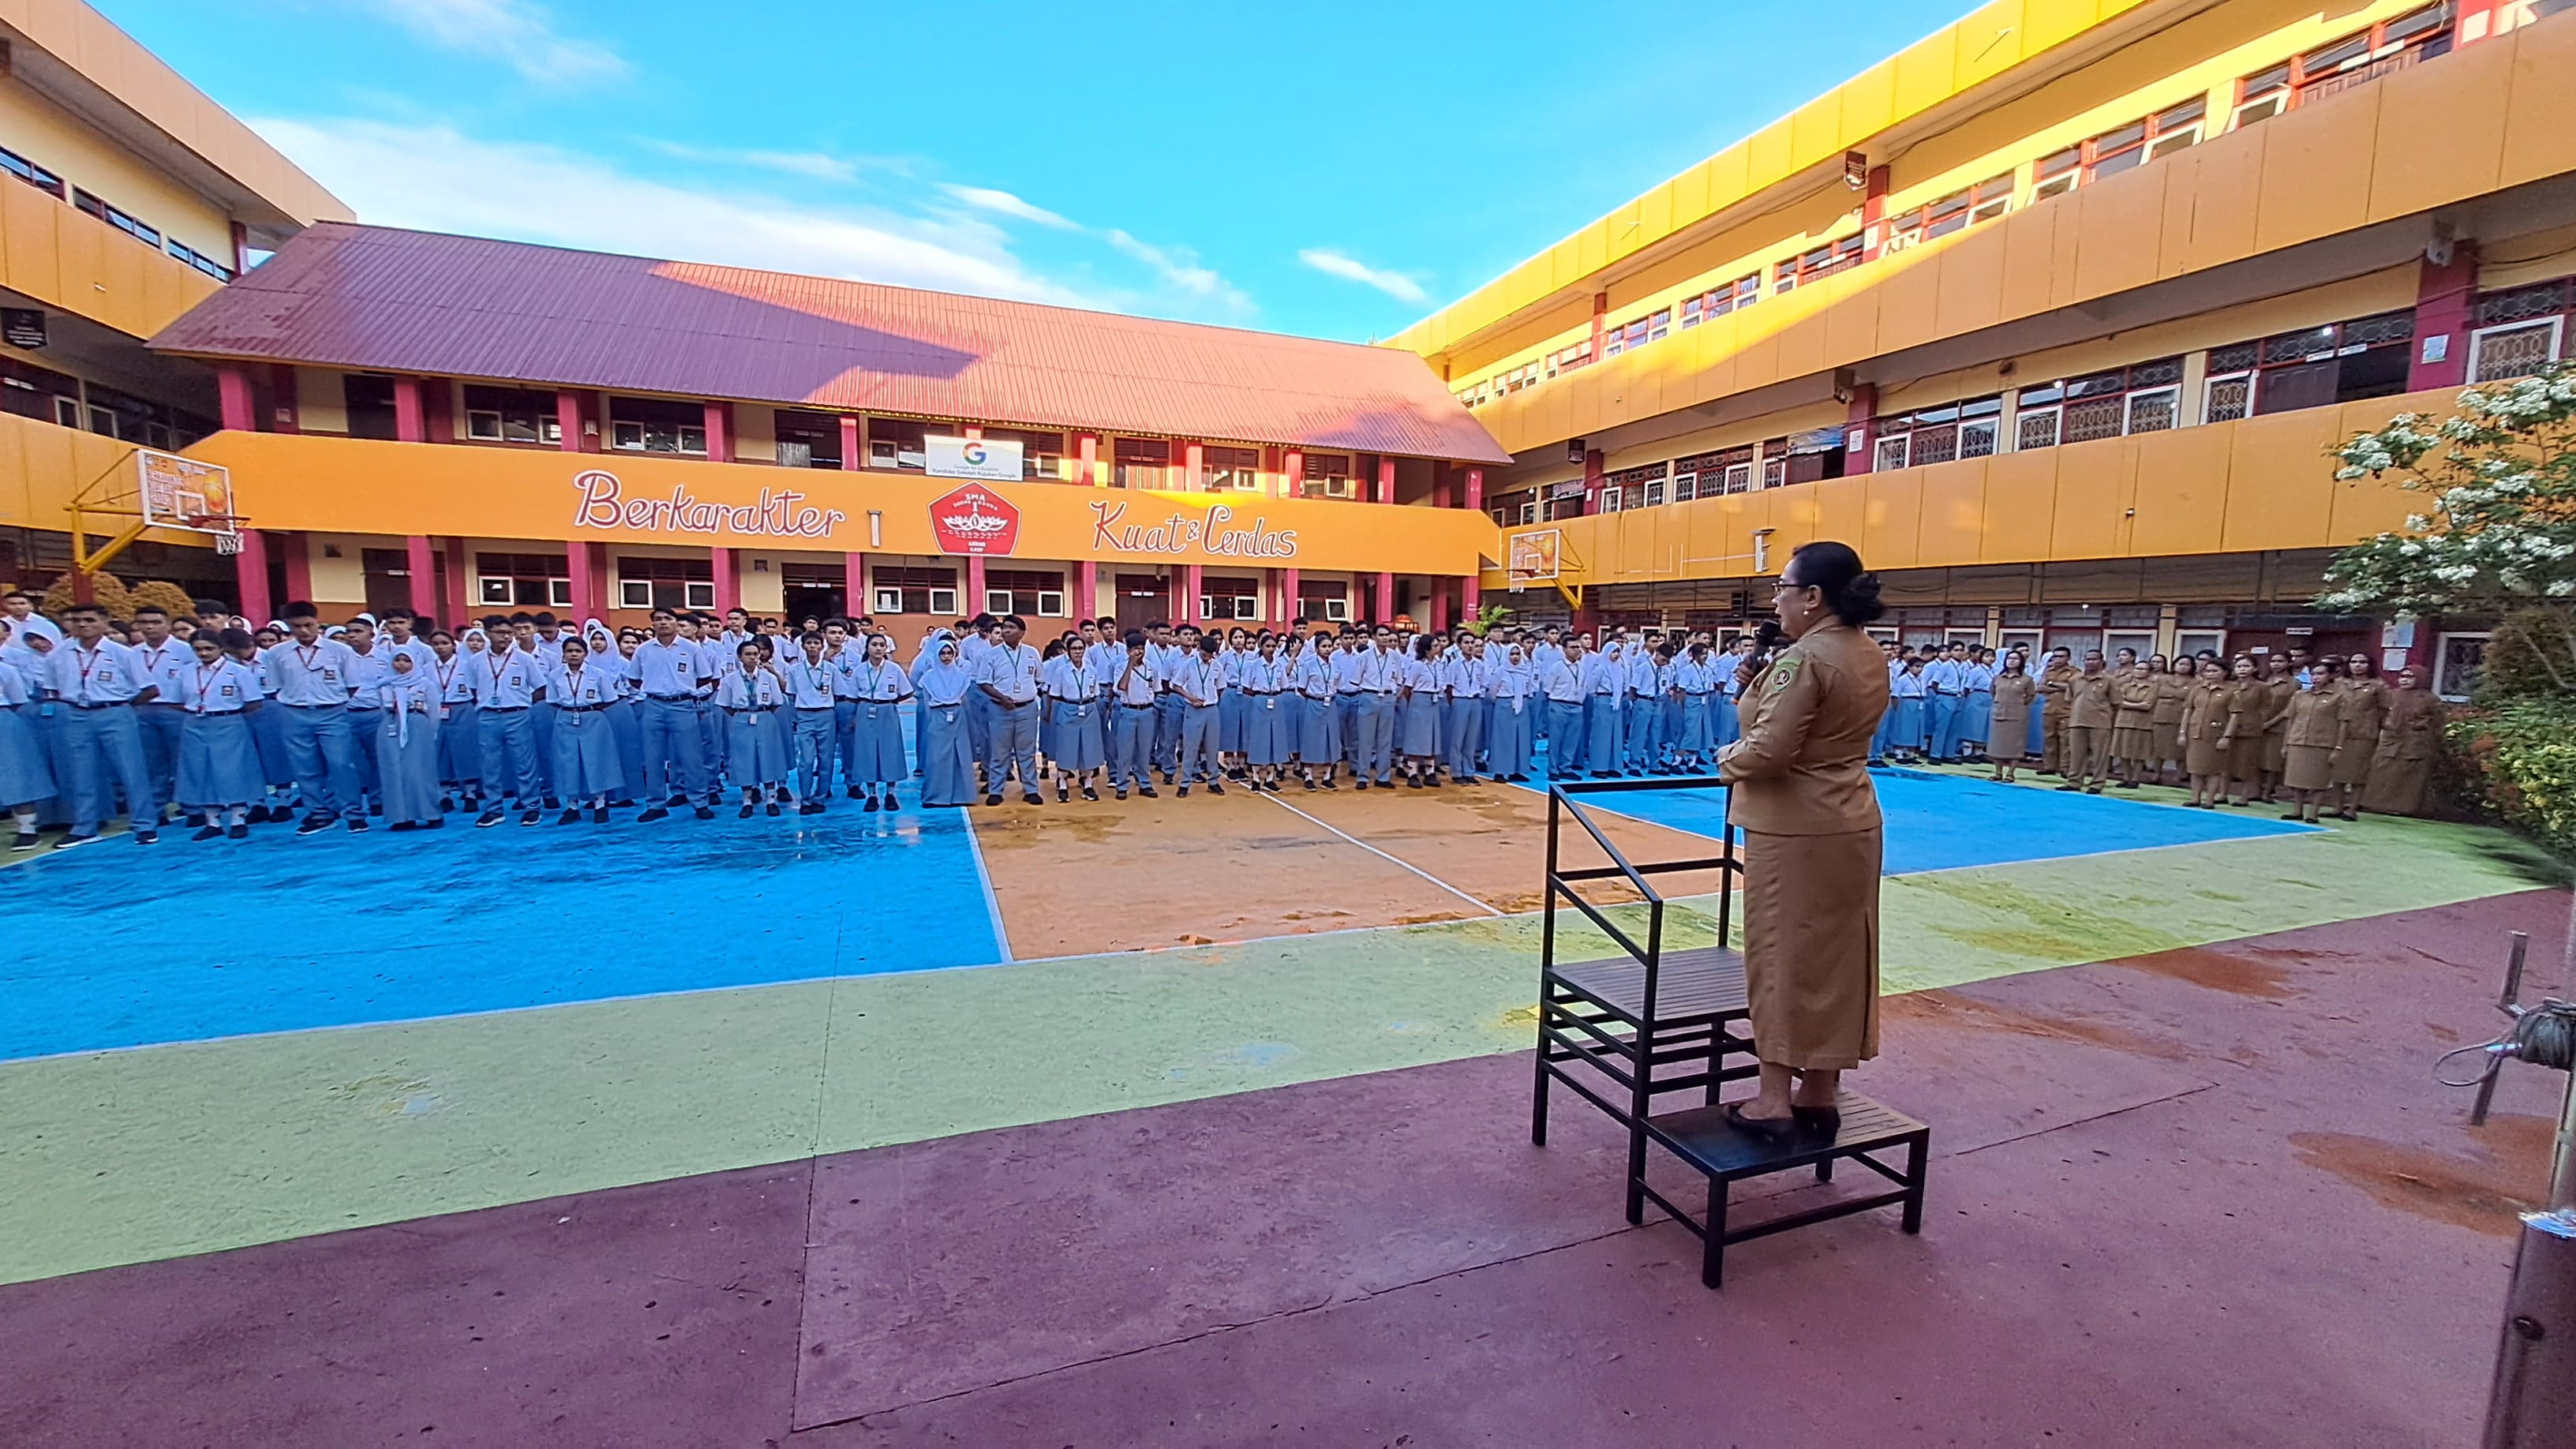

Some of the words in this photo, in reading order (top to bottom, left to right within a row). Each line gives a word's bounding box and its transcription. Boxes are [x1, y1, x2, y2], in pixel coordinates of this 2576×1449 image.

[963, 442, 987, 465] G
[574, 470, 845, 538] Berkarakter
[972, 501, 979, 511] 1
[1089, 500, 1186, 552] Kuat
[1187, 519, 1200, 541] &
[1202, 503, 1297, 558] Cerdas
